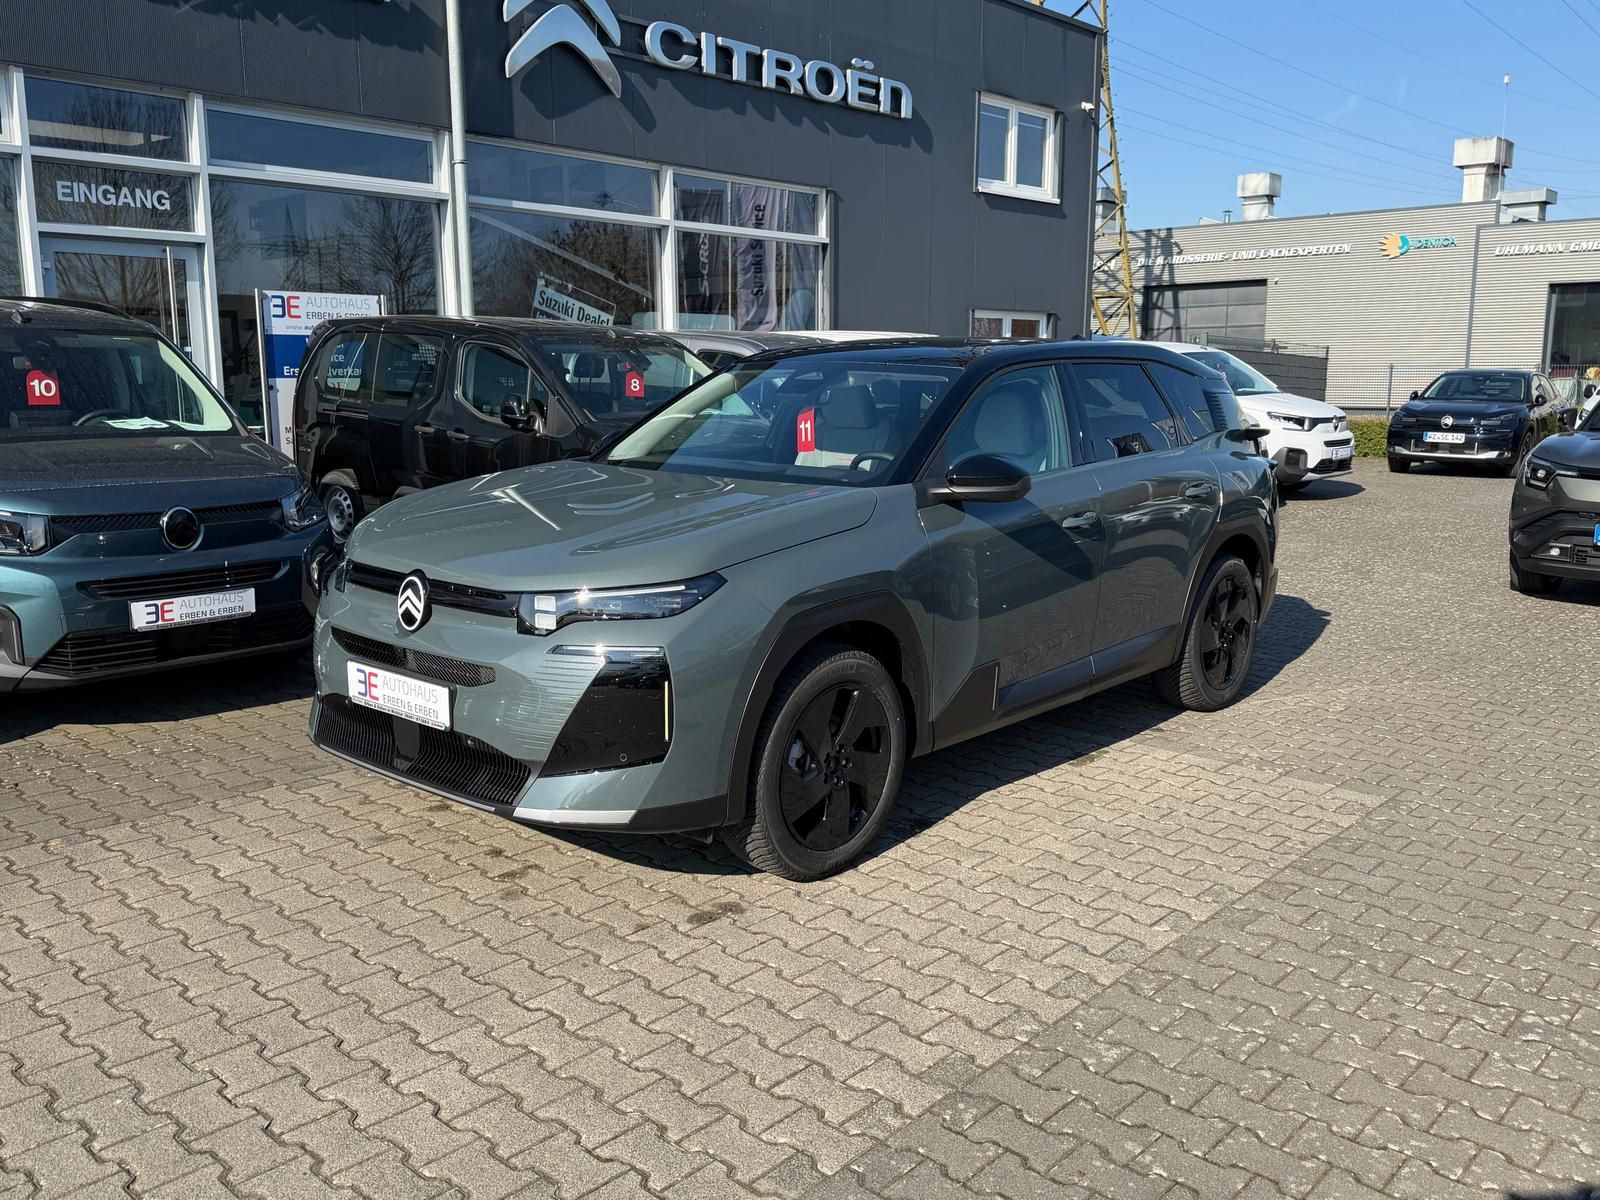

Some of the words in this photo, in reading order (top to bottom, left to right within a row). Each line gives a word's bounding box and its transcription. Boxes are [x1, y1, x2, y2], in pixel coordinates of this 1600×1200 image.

[56, 180, 171, 212] EINGANG
[1232, 250, 1257, 261] UND
[1260, 243, 1352, 259] LACKEXPERTEN
[1494, 243, 1565, 256] UHLMANN
[752, 253, 764, 297] Suzuki
[306, 296, 371, 310] AUTOHAUS
[538, 290, 575, 318] Suzuki
[306, 311, 334, 320] ERBEN
[30, 379, 56, 397] 10
[630, 378, 640, 392] 8
[799, 419, 811, 443] 11
[180, 592, 244, 610] AUTOHAUS
[180, 610, 208, 620] ERBEN
[209, 608, 216, 617] &
[218, 605, 244, 615] ERBEN
[382, 675, 438, 704] AUTOHAUS
[383, 694, 406, 709] ERBEN
[407, 701, 413, 712] &
[415, 704, 439, 720] ERBEN
